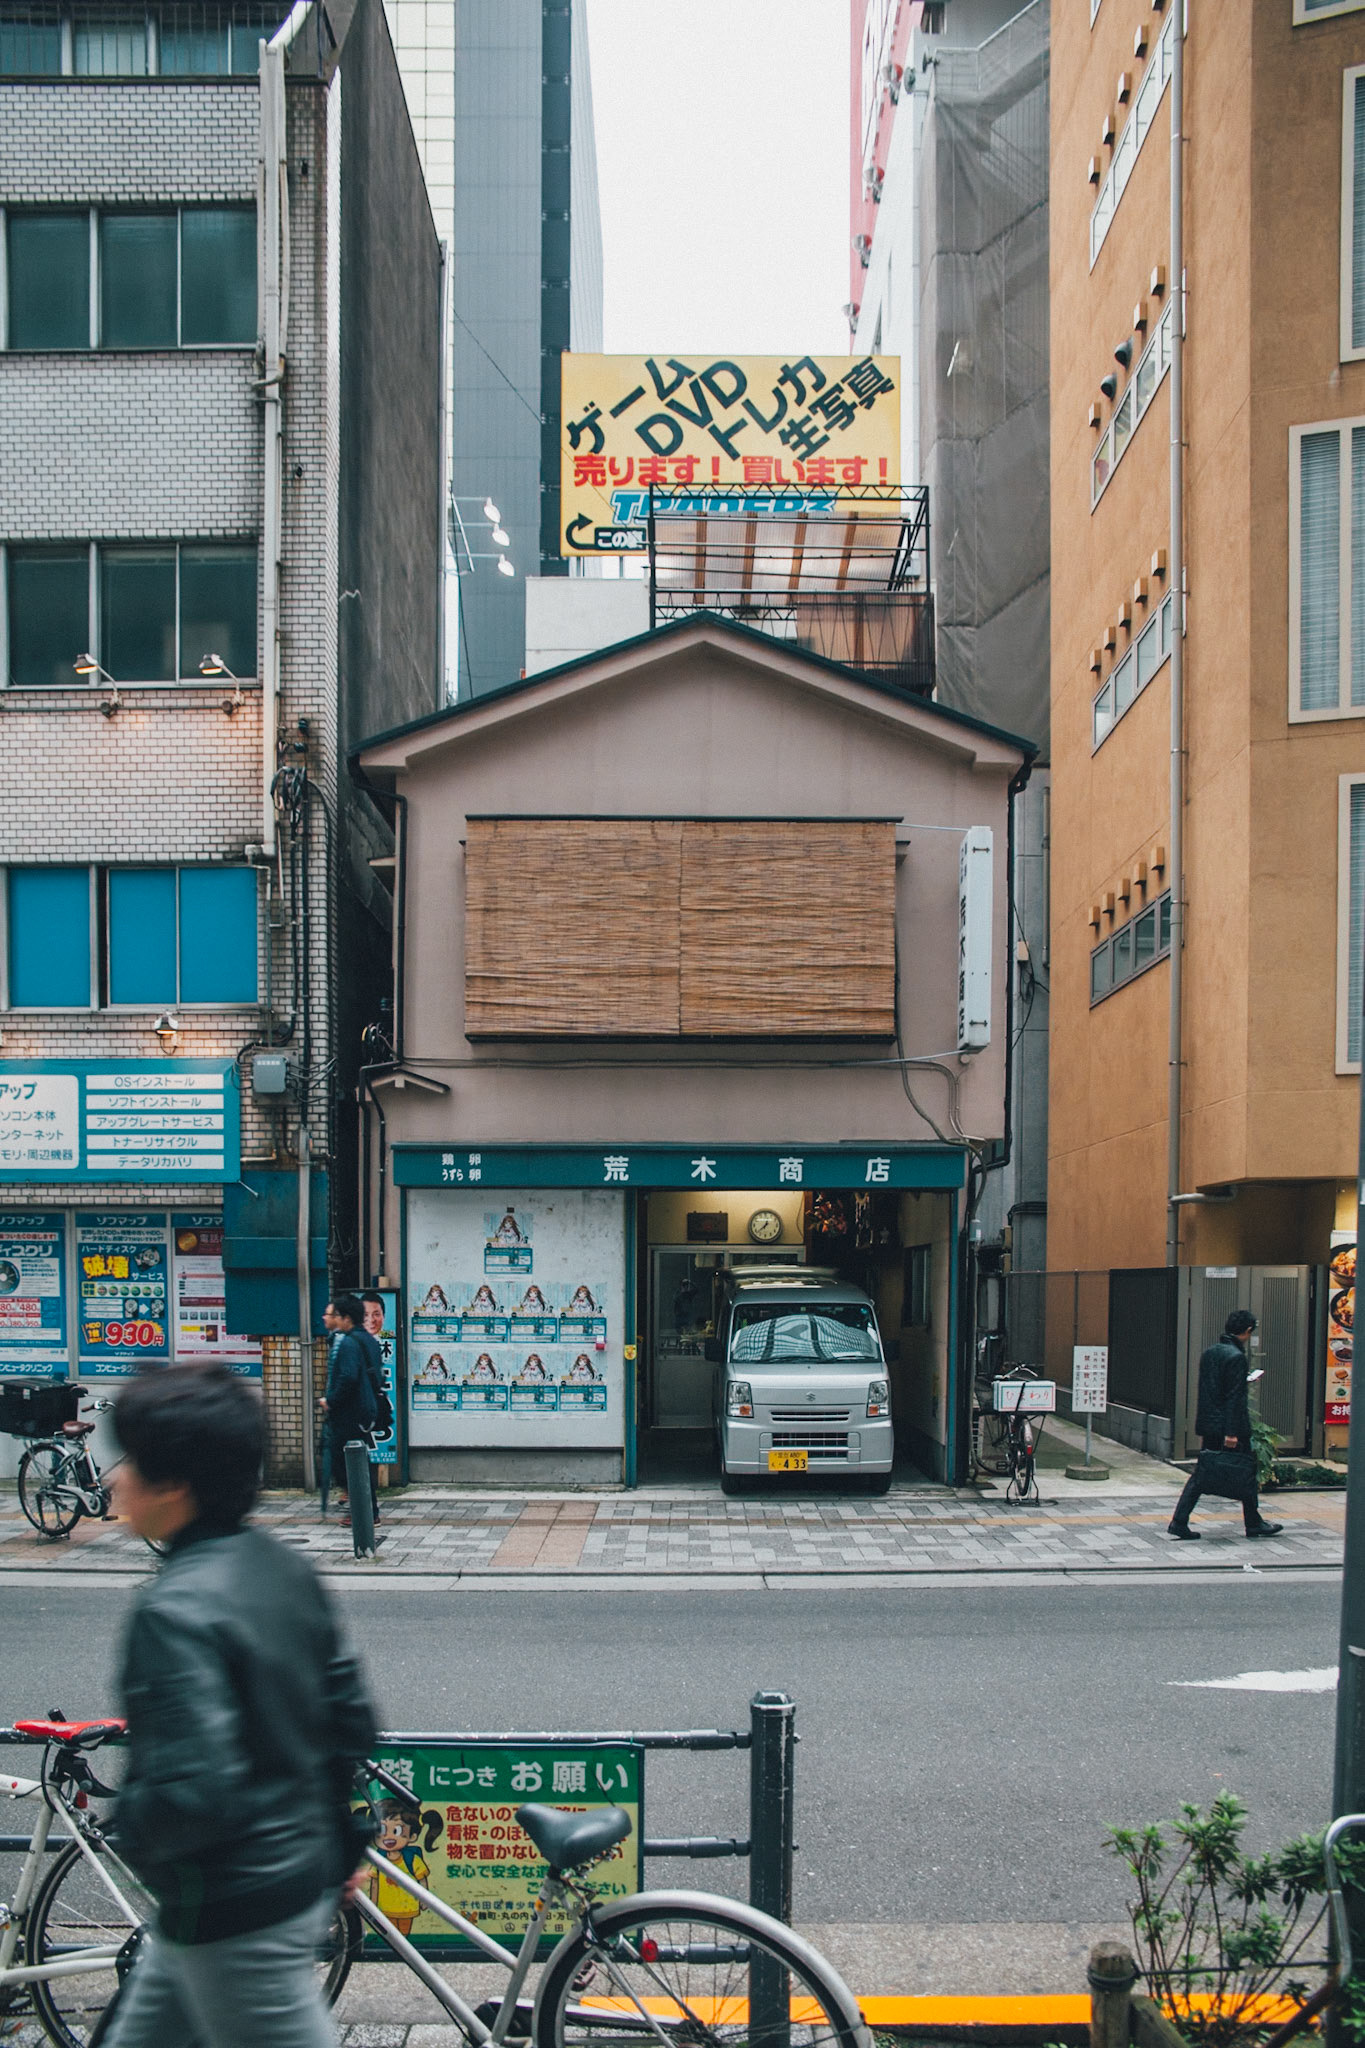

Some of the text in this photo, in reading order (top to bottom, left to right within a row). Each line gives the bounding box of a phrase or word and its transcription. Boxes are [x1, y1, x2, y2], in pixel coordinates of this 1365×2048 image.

[567, 358, 696, 454] ゲーム
[635, 361, 747, 456] DVD
[708, 356, 827, 461] トレカ
[778, 357, 895, 462] 生写真
[114, 1077, 195, 1087] OSインストール
[108, 1097, 201, 1107] ソフトインストール
[113, 1137, 198, 1147] トナーリサイクル
[118, 1157, 192, 1167] データリカバリ
[603, 1156, 890, 1182] 荒木商店
[96, 1216, 147, 1225] ソフマップ
[81, 1245, 137, 1253] ハードディスク
[131, 1272, 164, 1281] サービス
